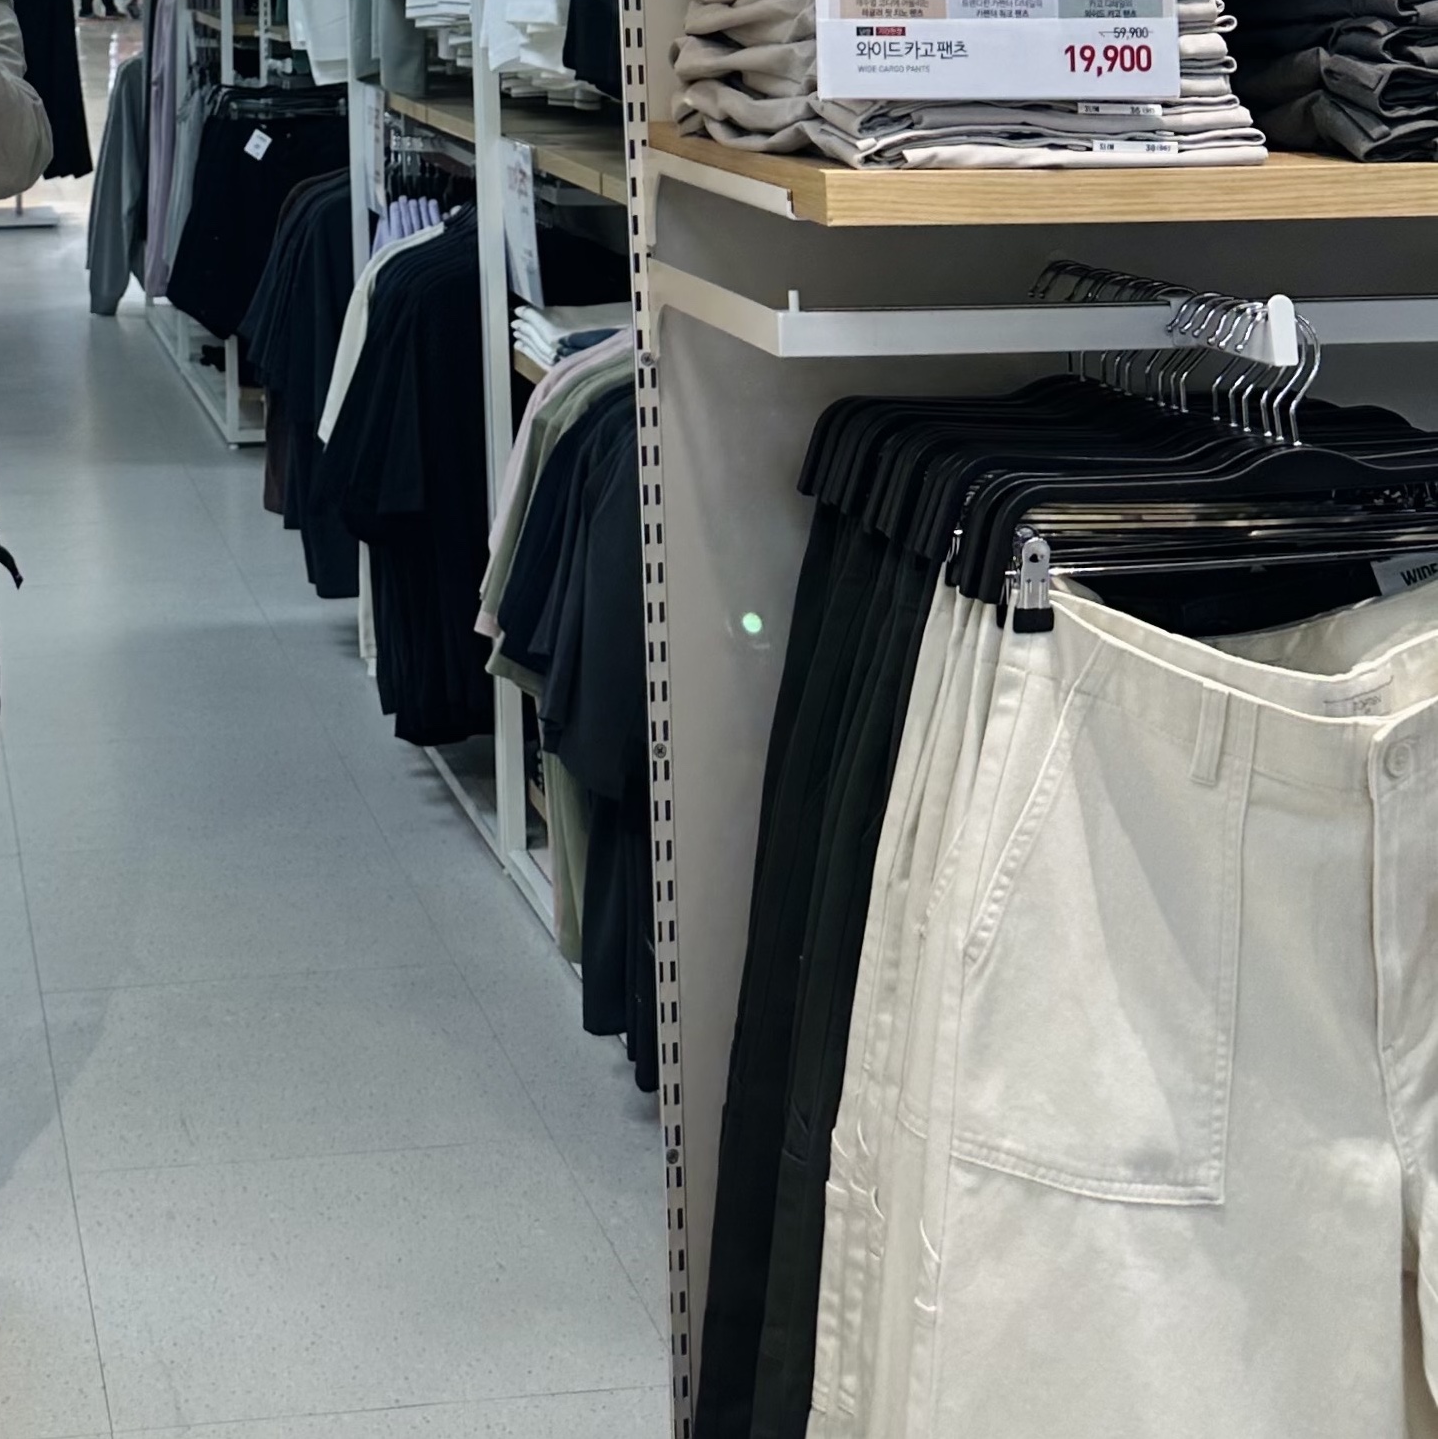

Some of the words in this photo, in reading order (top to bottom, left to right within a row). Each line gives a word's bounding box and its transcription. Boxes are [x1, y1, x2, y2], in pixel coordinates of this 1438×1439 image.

[1113, 27, 1149, 40] 59,900
[856, 40, 904, 60] 와이드
[905, 40, 936, 60] 카고
[937, 40, 969, 60] 팬츠
[1064, 44, 1152, 77] 19,900
[857, 65, 877, 73] WIDE
[878, 65, 905, 73] CARGO
[905, 65, 930, 73] PANTS
